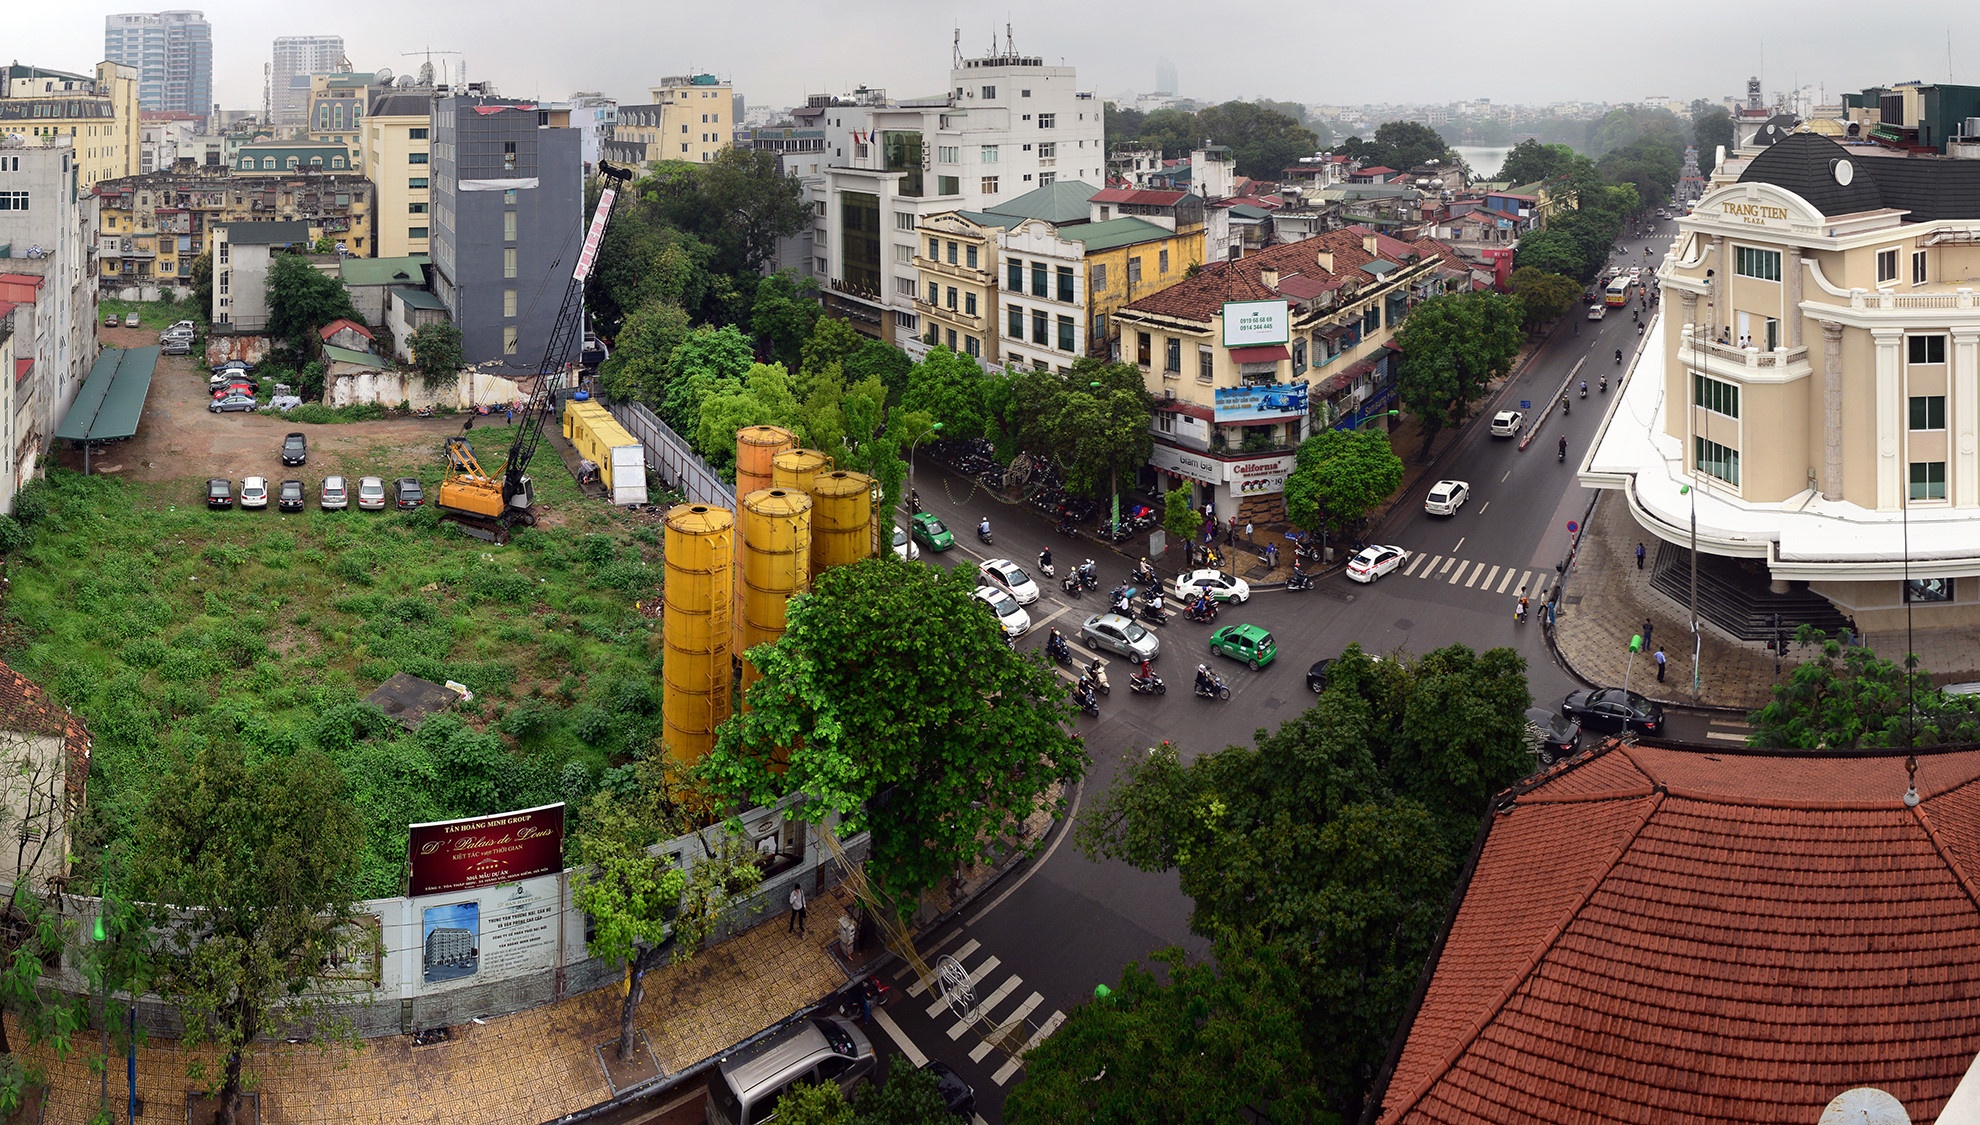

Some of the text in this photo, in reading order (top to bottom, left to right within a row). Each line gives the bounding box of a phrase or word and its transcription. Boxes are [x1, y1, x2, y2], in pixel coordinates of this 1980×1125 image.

[1722, 202, 1788, 220] TRANG TIEN
[1743, 216, 1765, 225] PLAZA
[1233, 463, 1279, 474] California
[445, 815, 532, 833] TÂN HOÀNG MINH GROUP
[453, 836, 496, 851] Palais
[496, 834, 512, 845] de
[514, 826, 553, 841] Louis
[467, 850, 480, 858] TÁC
[507, 844, 523, 852] GIAN
